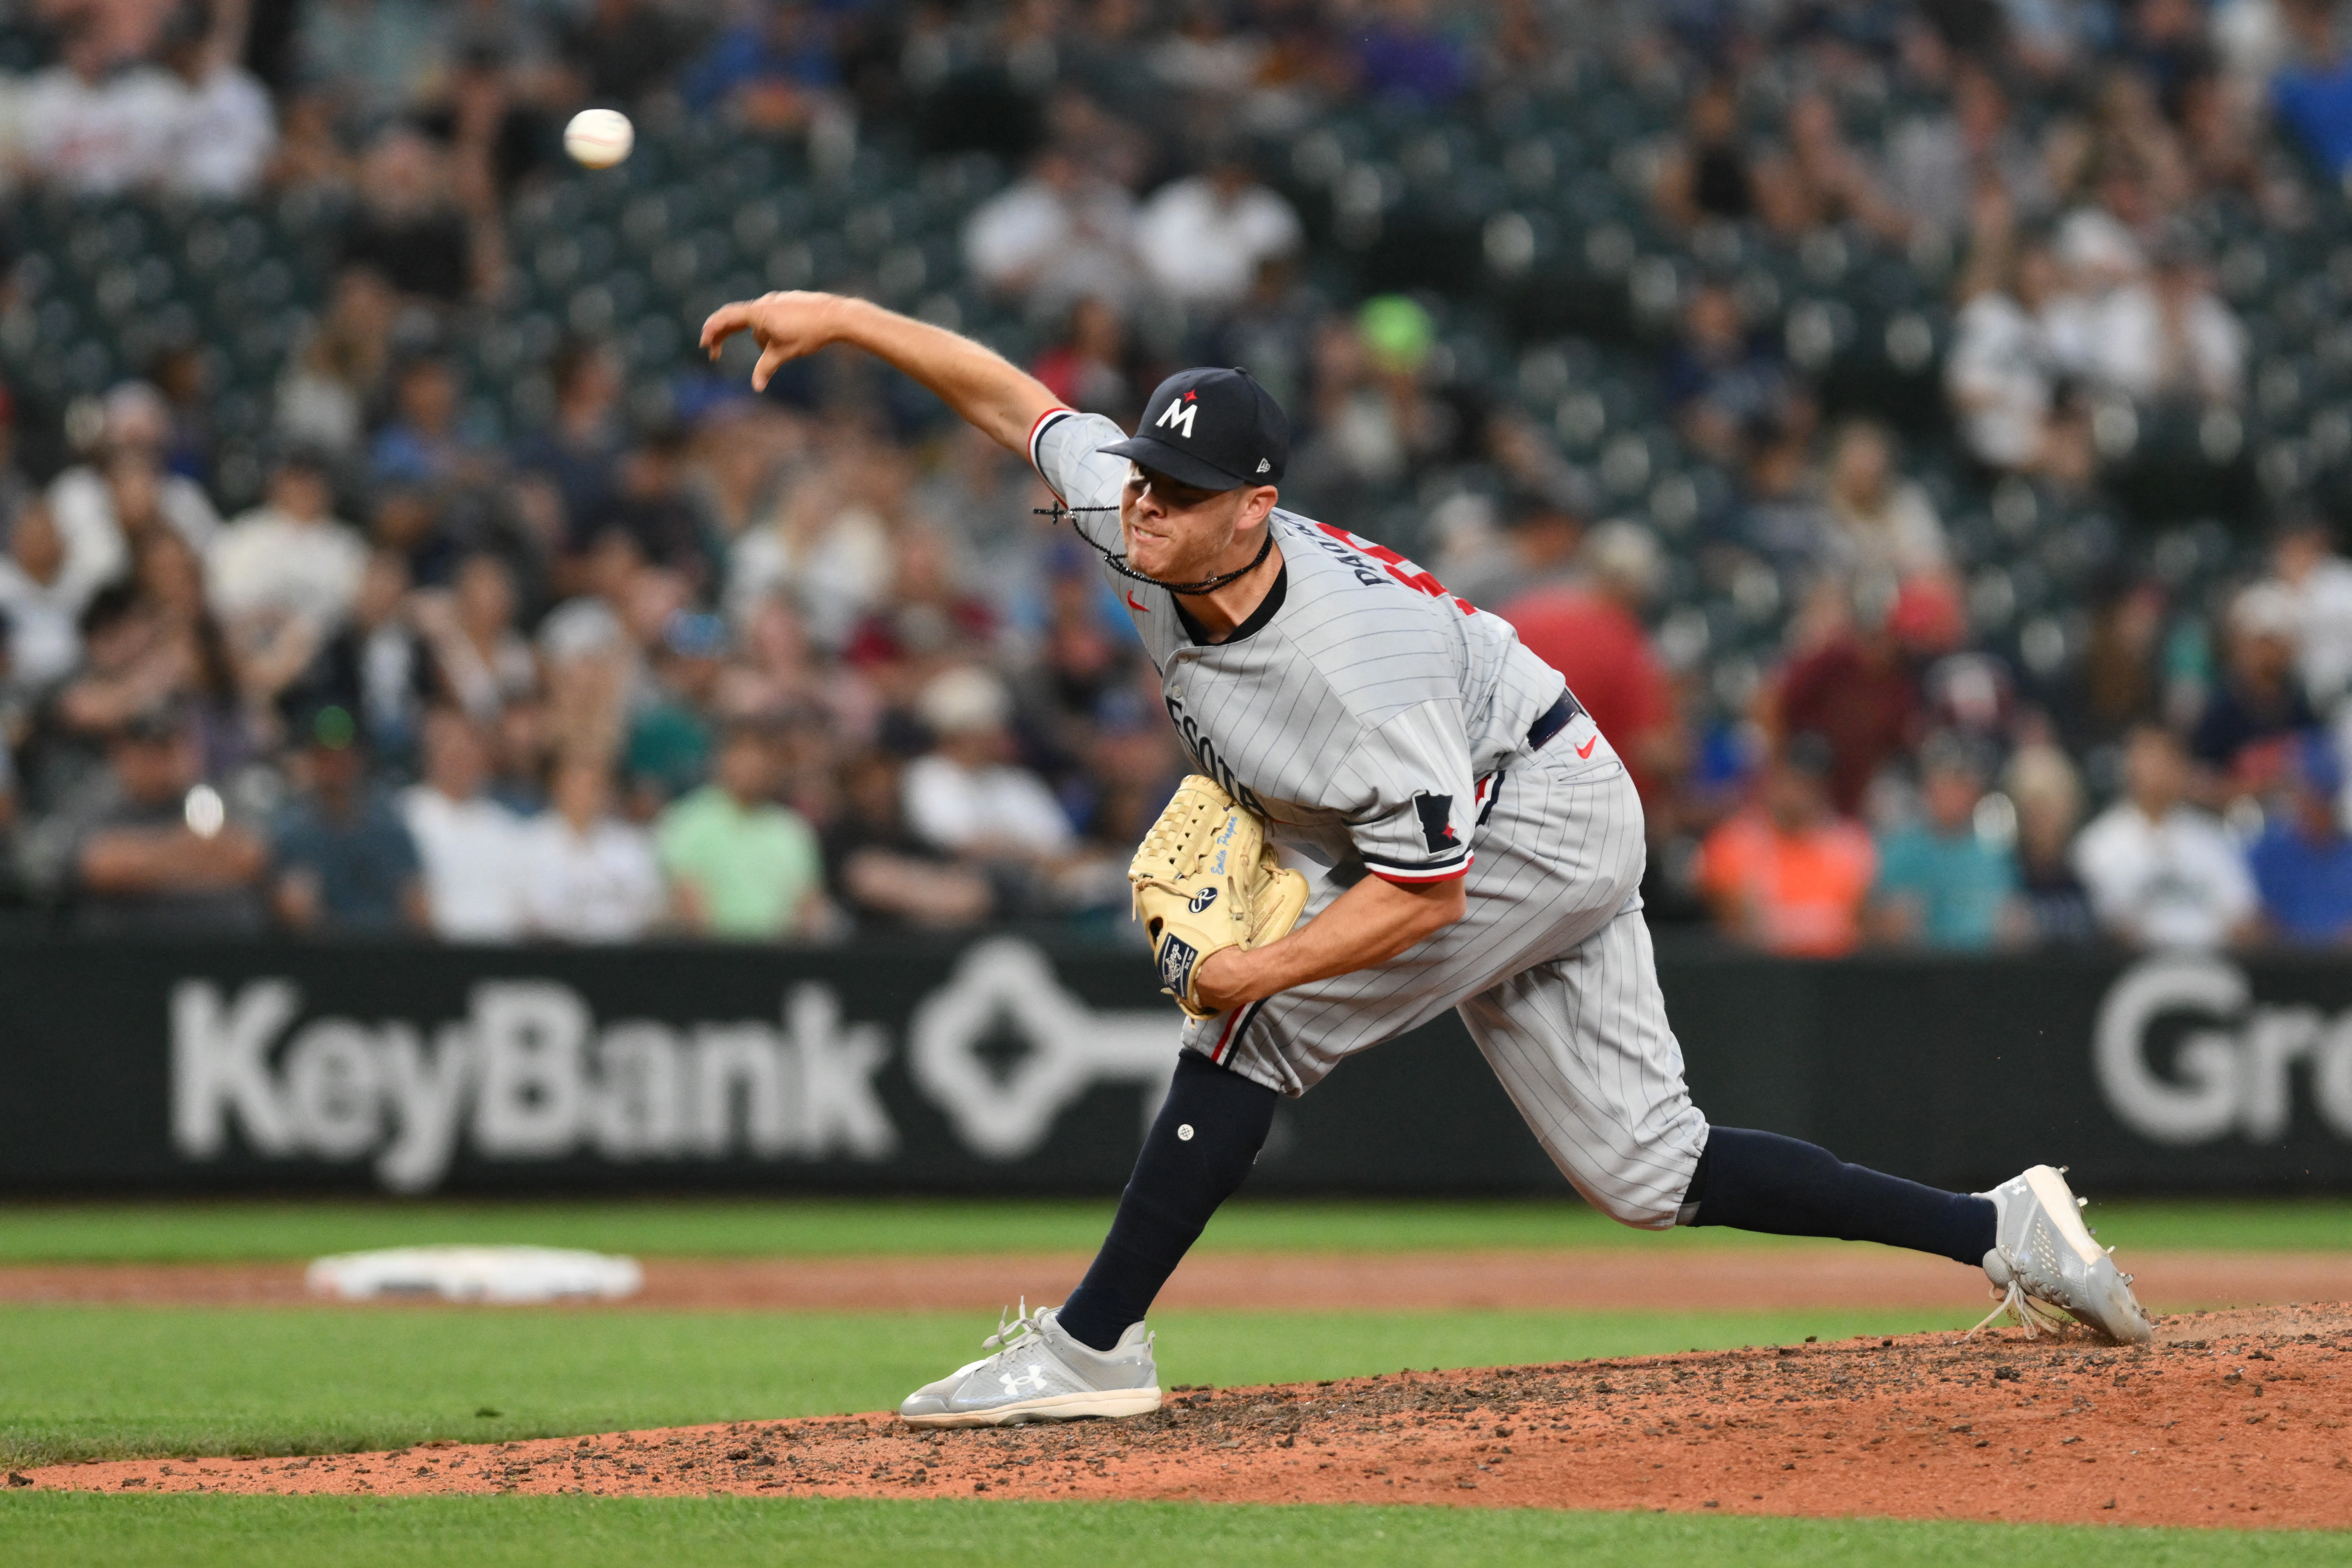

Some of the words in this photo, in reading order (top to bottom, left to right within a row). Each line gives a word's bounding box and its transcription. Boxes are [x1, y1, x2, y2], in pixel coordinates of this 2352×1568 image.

[1155, 398, 1197, 438] M
[1164, 944, 1181, 988] Rawlings
[167, 976, 897, 1192] KeyBank
